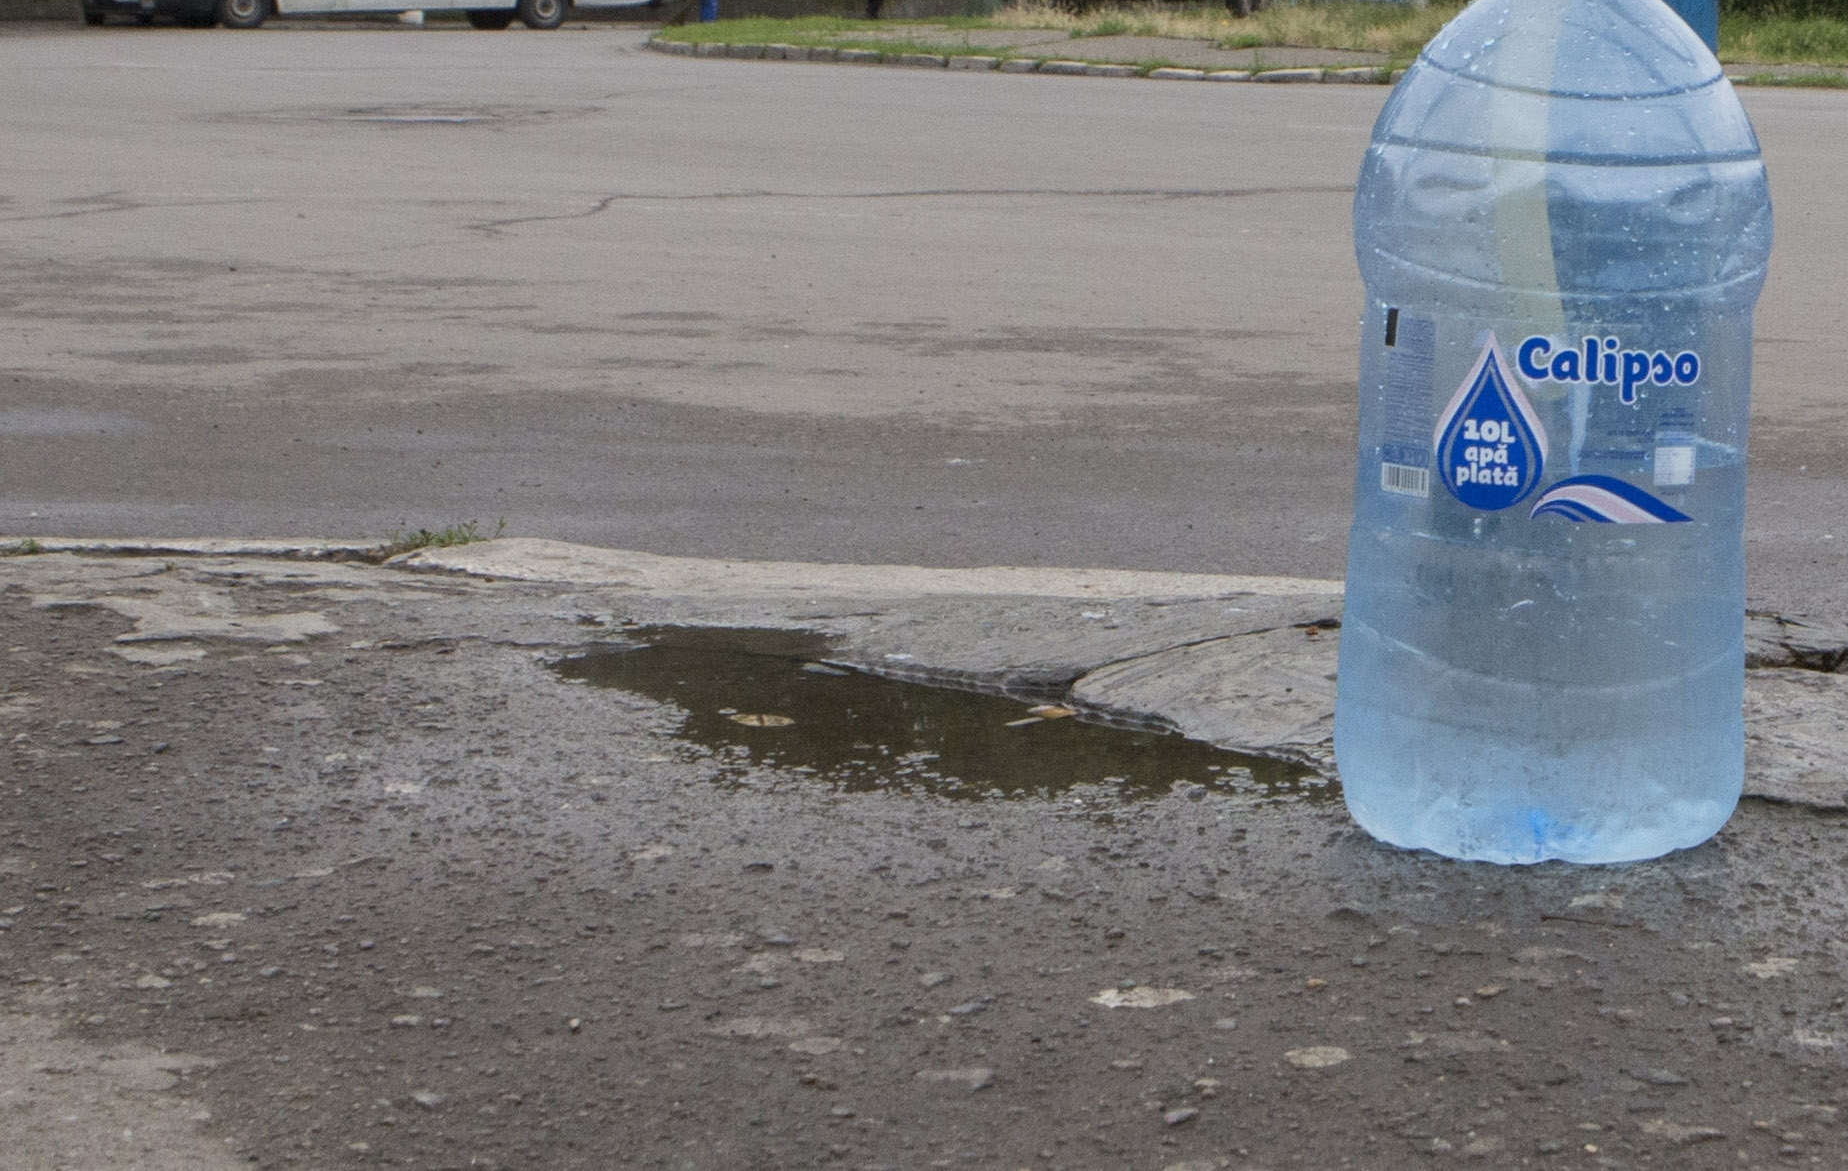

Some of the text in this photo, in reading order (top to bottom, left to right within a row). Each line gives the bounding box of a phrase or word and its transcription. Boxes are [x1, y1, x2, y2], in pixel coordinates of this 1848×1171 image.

[1517, 337, 1699, 403] Calipso
[1463, 419, 1516, 443] 10L
[1464, 444, 1508, 467] apă
[1456, 461, 1519, 487] plată
